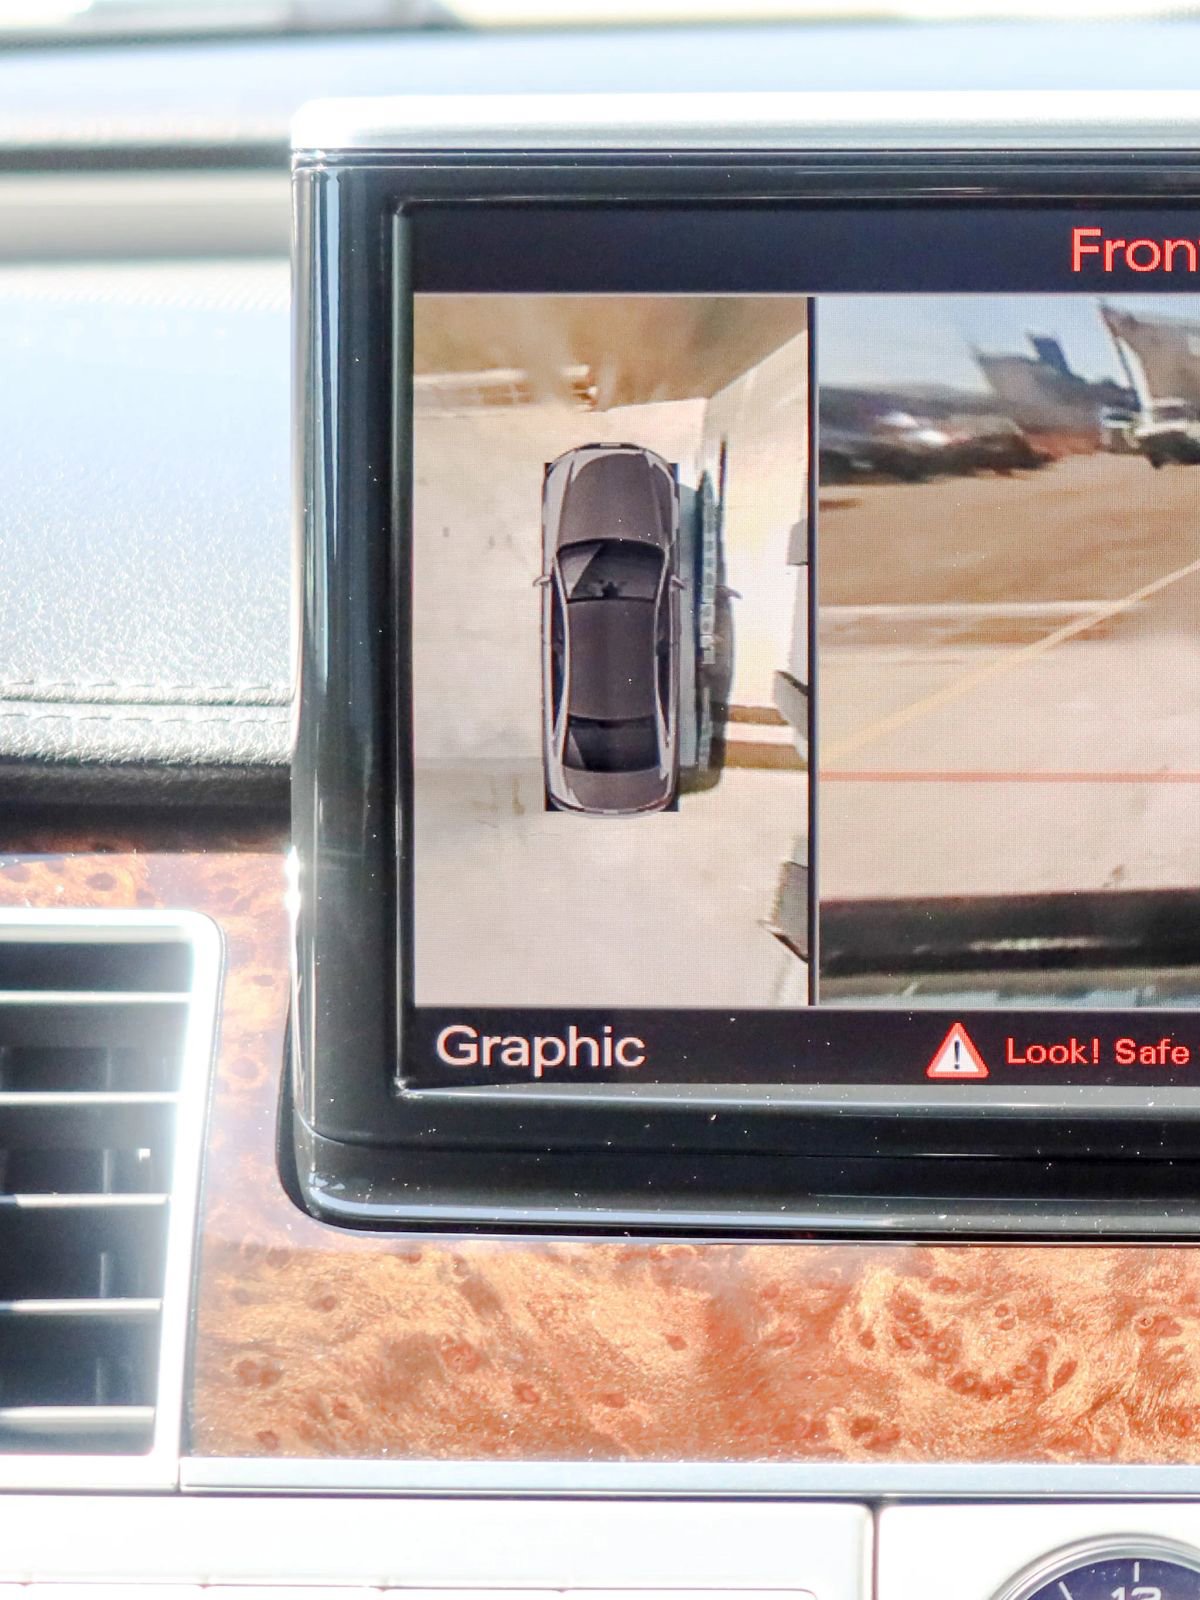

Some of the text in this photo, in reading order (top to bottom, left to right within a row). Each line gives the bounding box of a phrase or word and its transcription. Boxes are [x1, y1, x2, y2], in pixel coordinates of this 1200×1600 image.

[436, 1024, 646, 1078] Graphic
[1005, 1037, 1100, 1065] Look!
[1114, 1038, 1190, 1065] Safe
